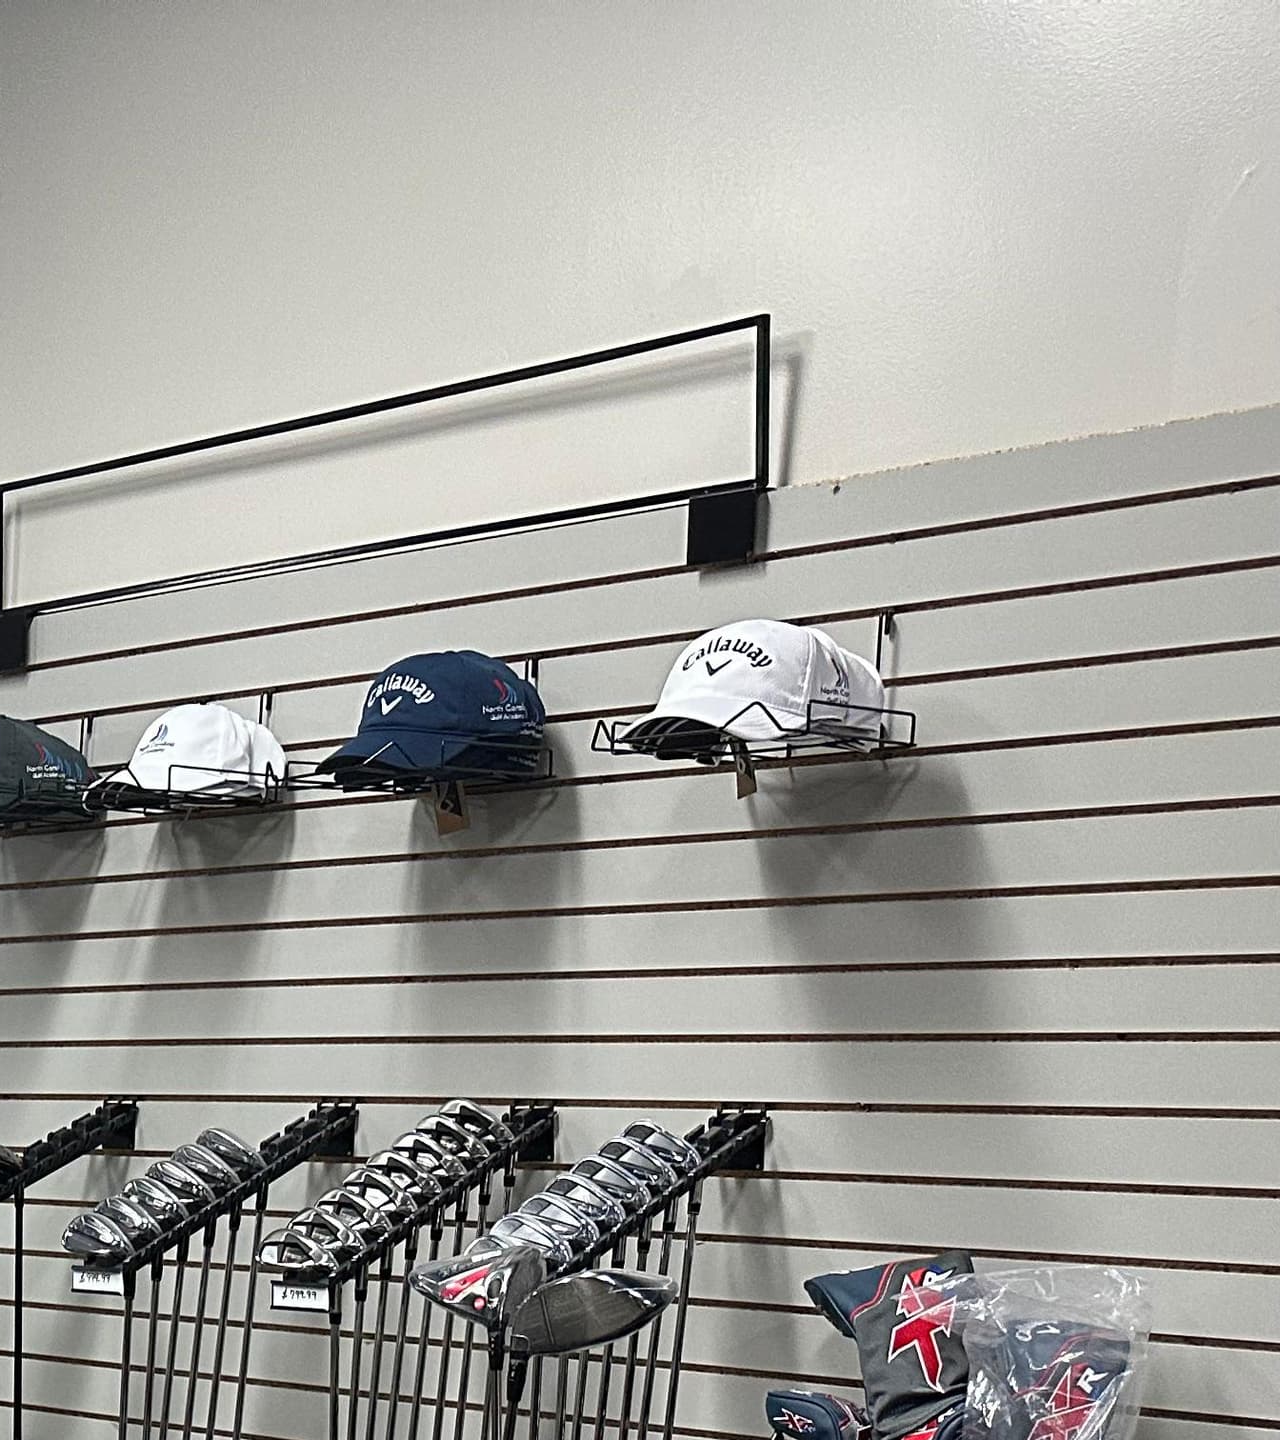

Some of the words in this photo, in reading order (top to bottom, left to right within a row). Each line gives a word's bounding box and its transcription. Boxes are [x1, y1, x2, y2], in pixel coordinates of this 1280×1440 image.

[682, 636, 773, 672] Callaway
[367, 673, 435, 708] Callaway
[482, 704, 504, 715] North
